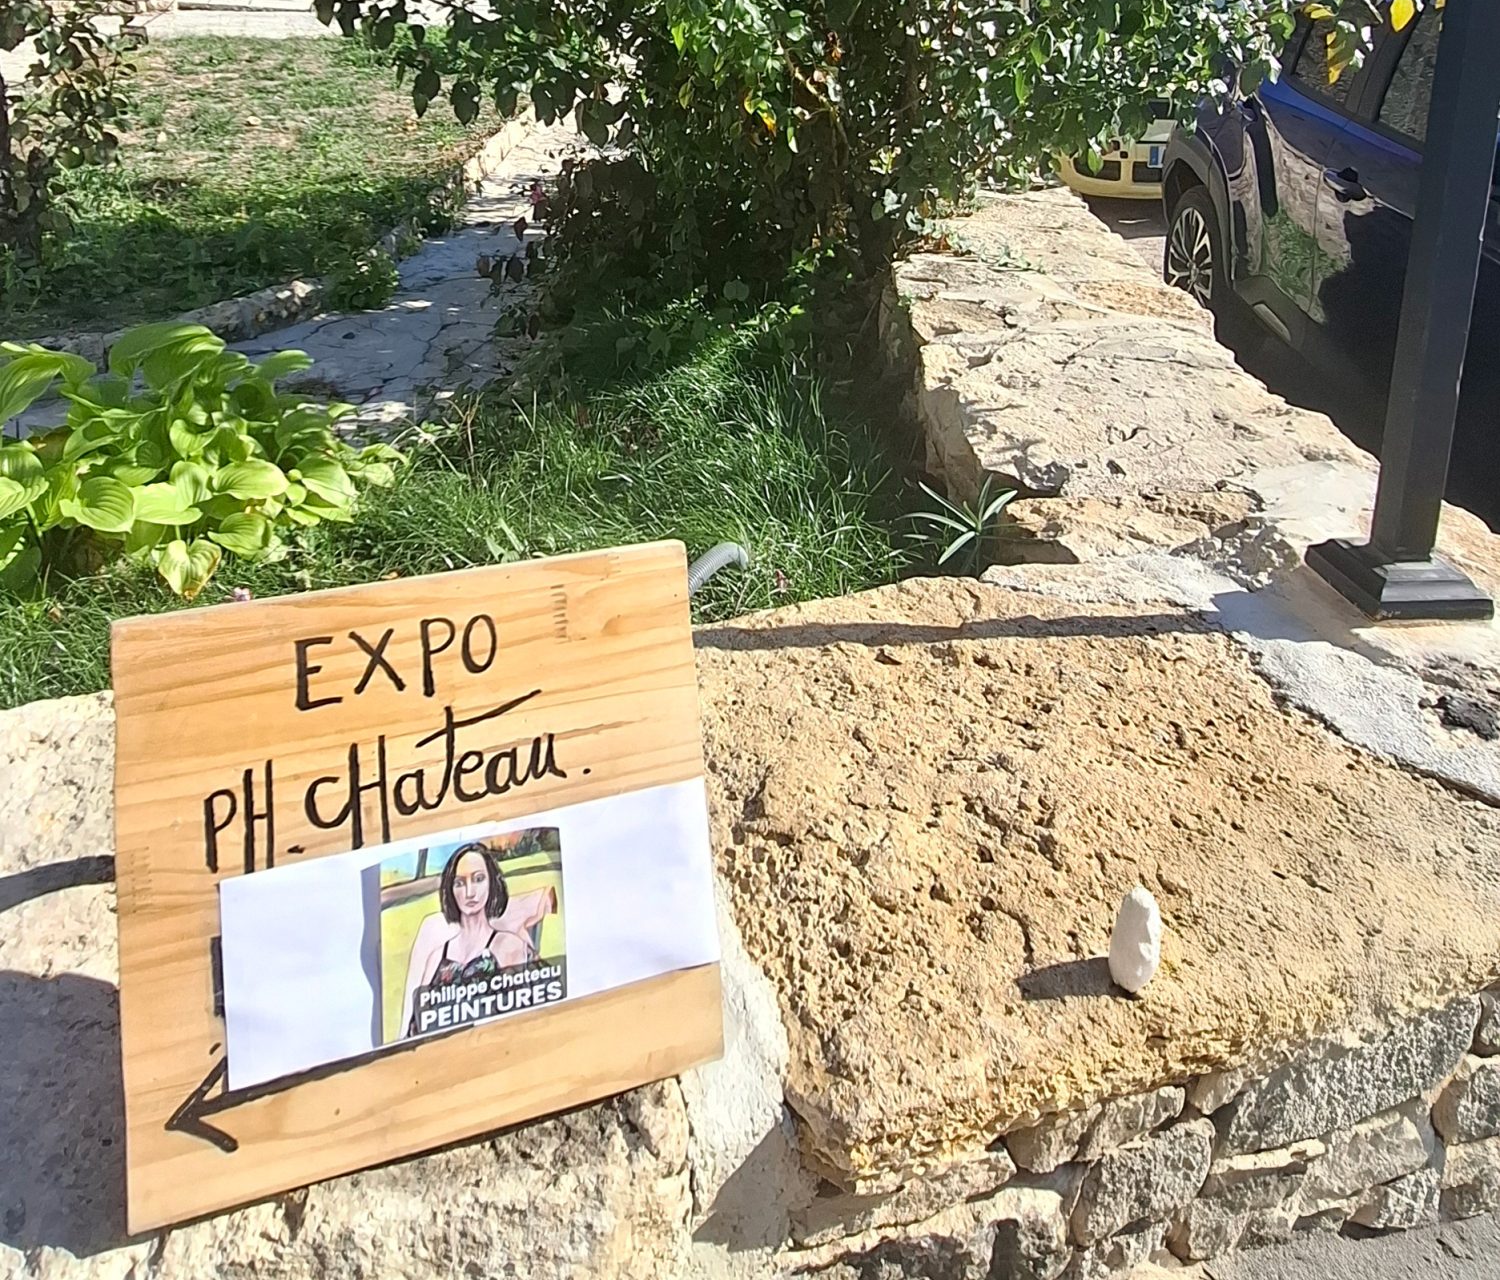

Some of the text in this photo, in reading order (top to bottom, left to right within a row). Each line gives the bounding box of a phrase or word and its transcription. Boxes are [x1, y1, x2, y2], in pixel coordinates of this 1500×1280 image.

[294, 614, 498, 712] EXPO
[419, 965, 561, 1007] Philippe Chateau
[420, 981, 562, 1032] PEINTURES
